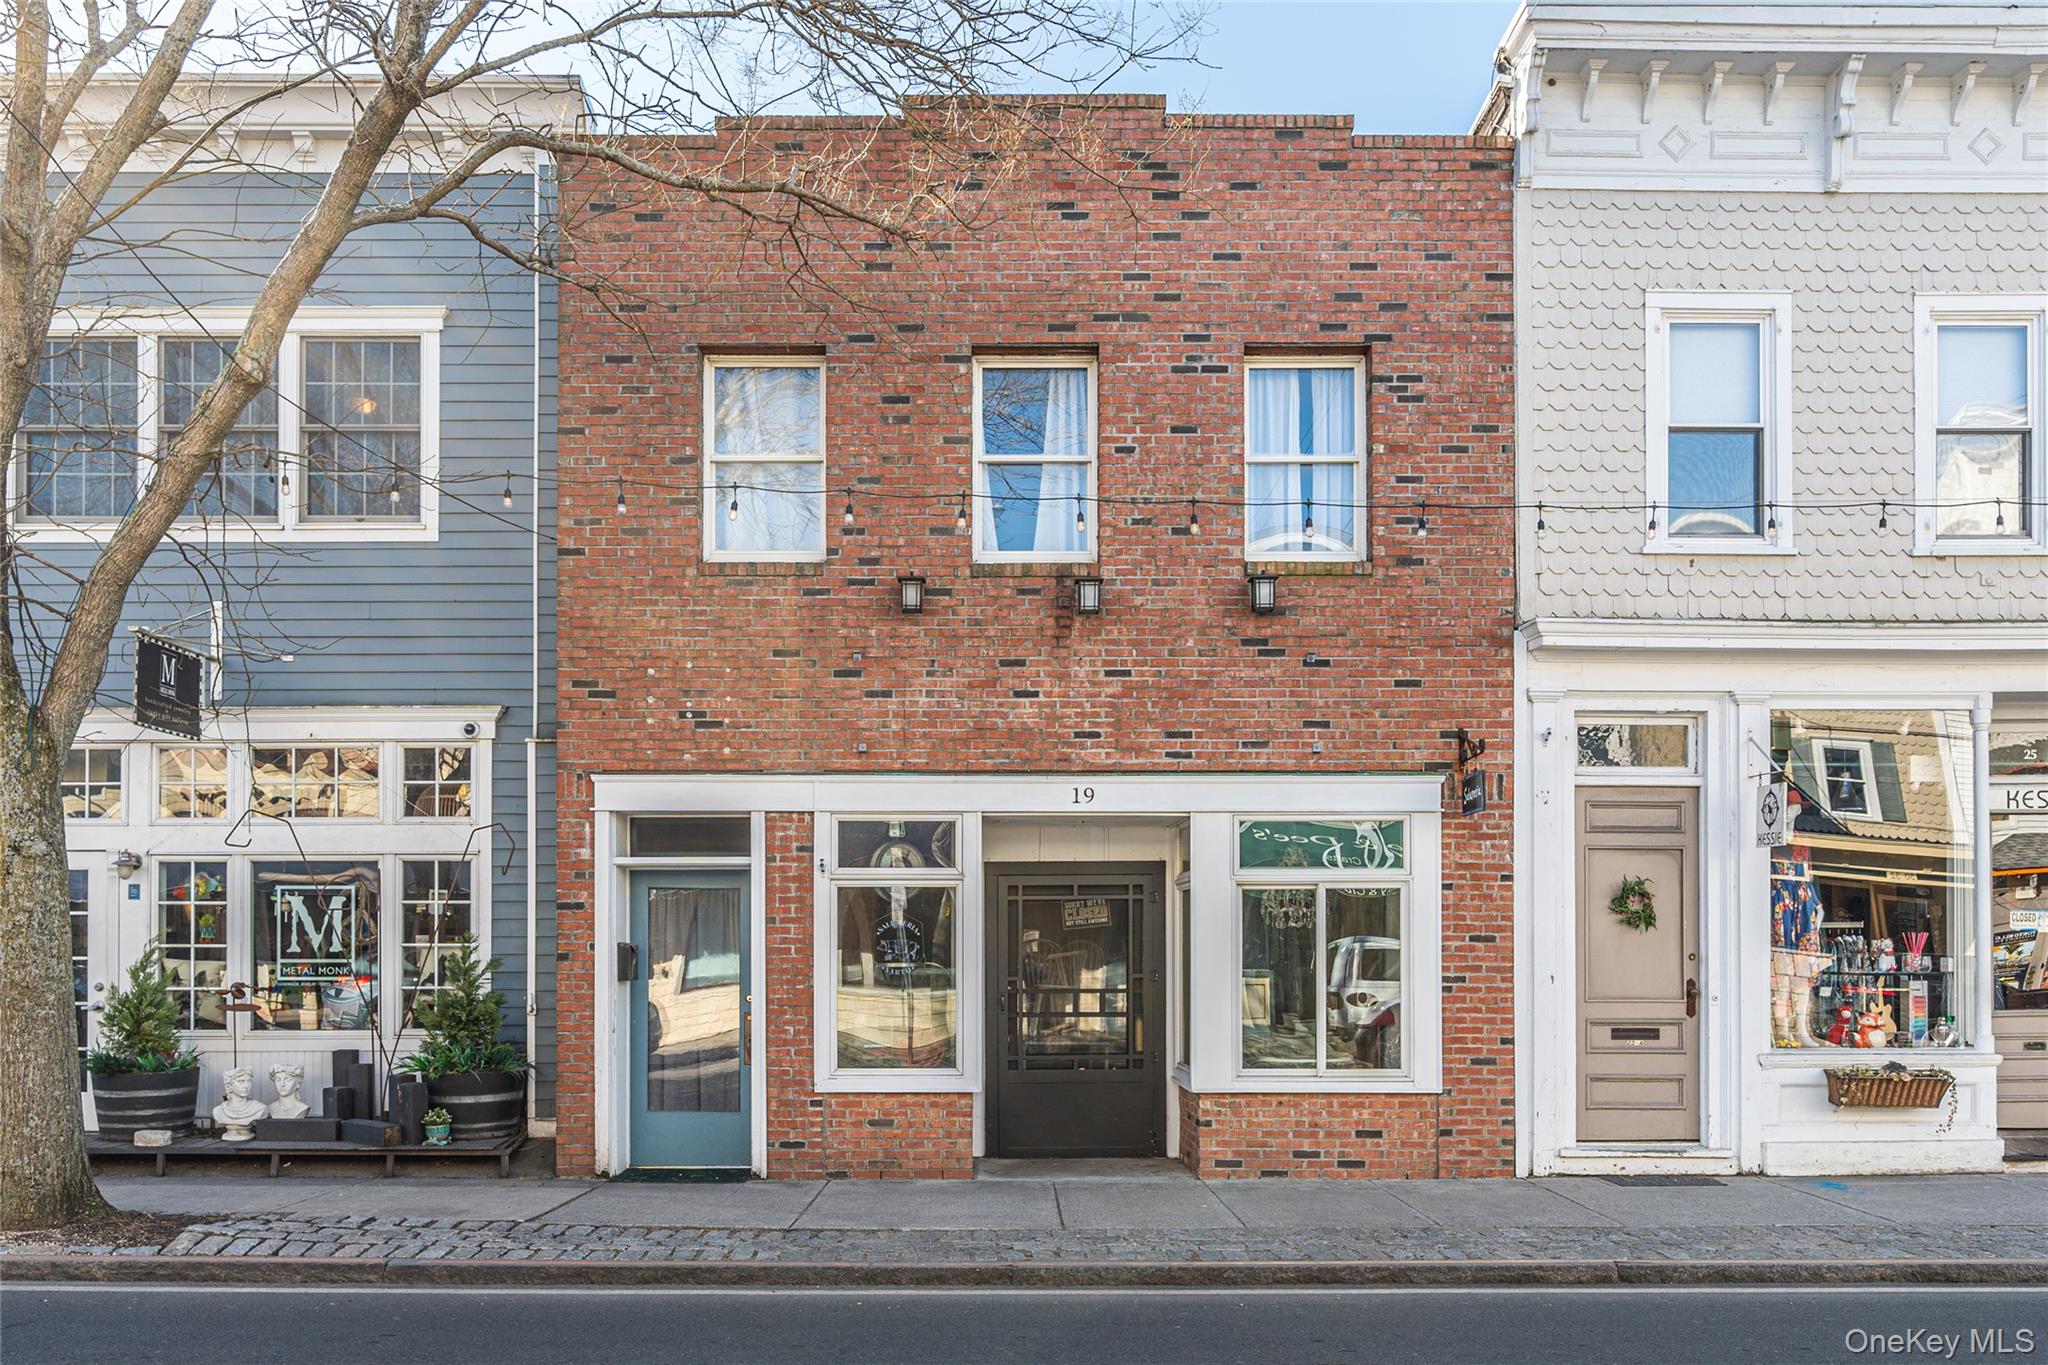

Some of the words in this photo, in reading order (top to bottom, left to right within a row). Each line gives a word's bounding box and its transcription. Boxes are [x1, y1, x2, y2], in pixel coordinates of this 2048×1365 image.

[161, 653, 176, 686] M
[2023, 749, 2037, 760] 25
[1072, 787, 1095, 803] 19
[2007, 790, 2048, 809] KES
[1757, 831, 1782, 846] KESSIE
[1064, 906, 1108, 921] CLOSED
[2011, 912, 2037, 922] CLOSED
[285, 893, 347, 953] M
[282, 966, 315, 975] METAL
[318, 966, 350, 975] MONK
